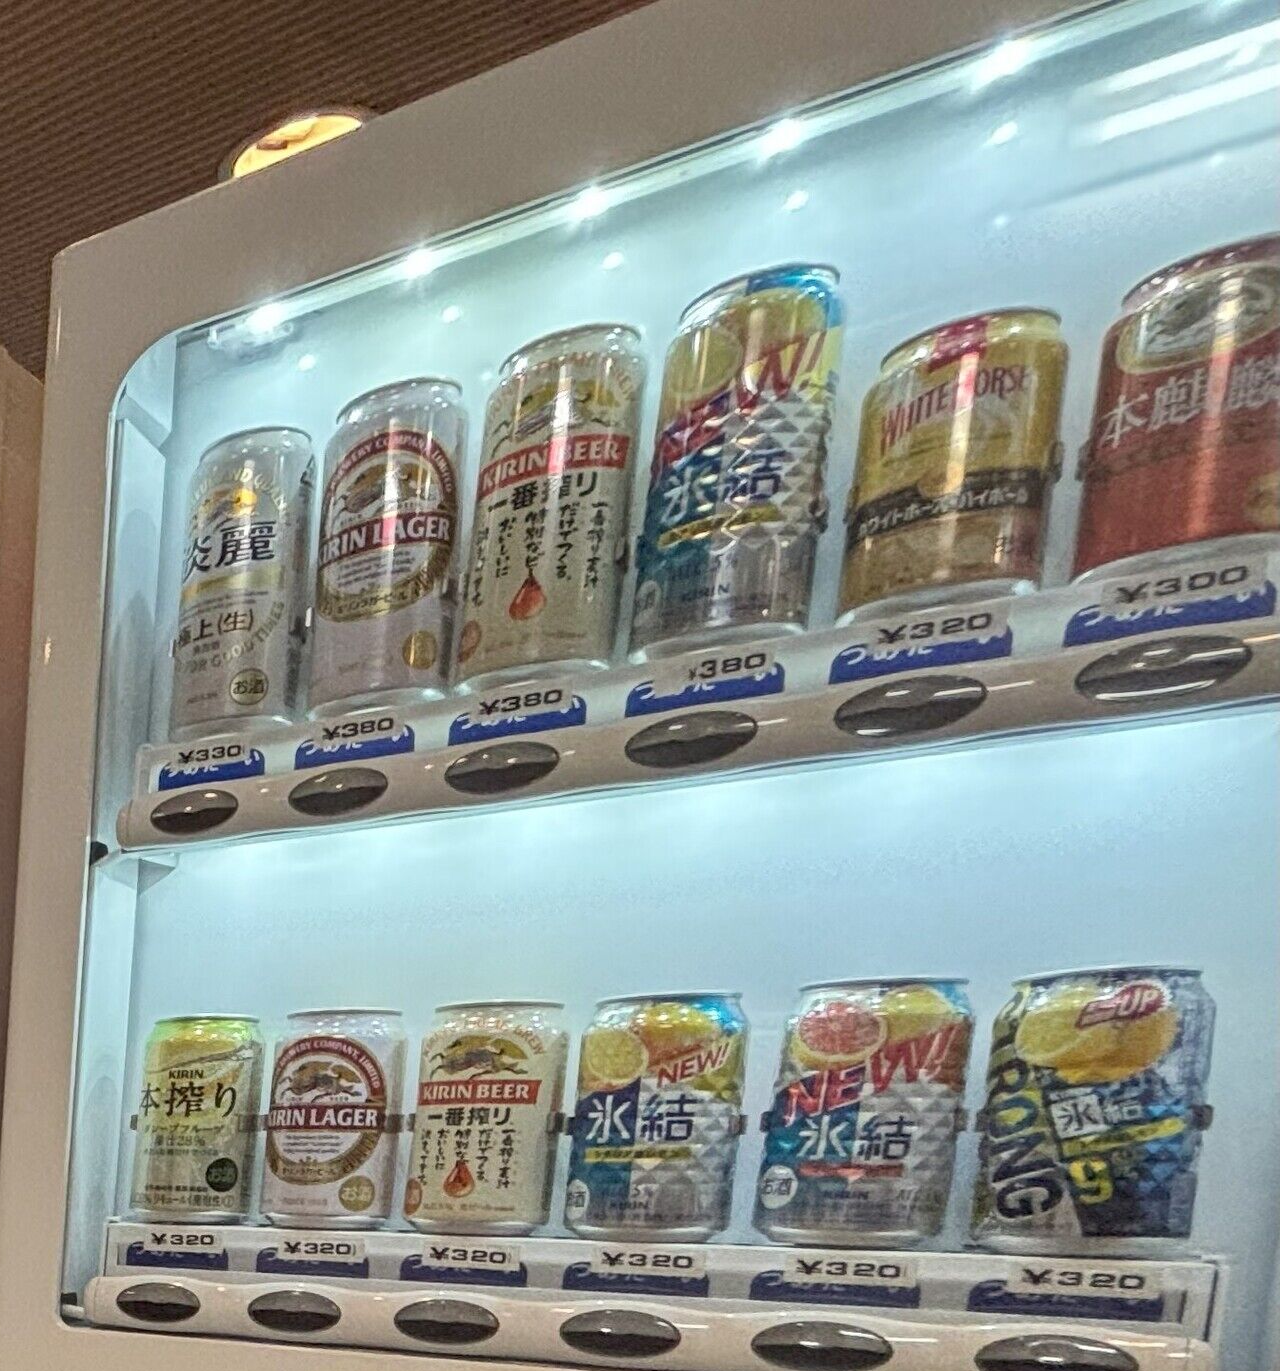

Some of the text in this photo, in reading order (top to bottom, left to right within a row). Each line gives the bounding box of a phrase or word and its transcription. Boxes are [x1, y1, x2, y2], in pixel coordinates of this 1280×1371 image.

[482, 447, 547, 493] KIRIN
[1115, 565, 1250, 603] ¥300
[878, 612, 993, 644] ¥320
[686, 653, 767, 683] ¥380
[479, 688, 564, 715] ¥380
[322, 717, 395, 742] ¥380
[178, 745, 242, 765] ¥330
[168, 1069, 204, 1079] KIRIN
[656, 1041, 731, 1087] NEW!
[784, 1021, 957, 1126] NEW!
[423, 1083, 530, 1101] KIRIN BEER
[310, 1108, 378, 1128] LAGER
[427, 1107, 514, 1127] 一番搾り
[587, 1096, 697, 1143] 氷結
[797, 1115, 918, 1161] 氷結
[151, 1233, 214, 1246] ¥320
[284, 1241, 351, 1256] ¥320
[429, 1246, 507, 1263] ¥320
[602, 1253, 693, 1269] ¥320
[797, 1259, 901, 1278] ¥320
[1021, 1268, 1146, 1290] ¥320
